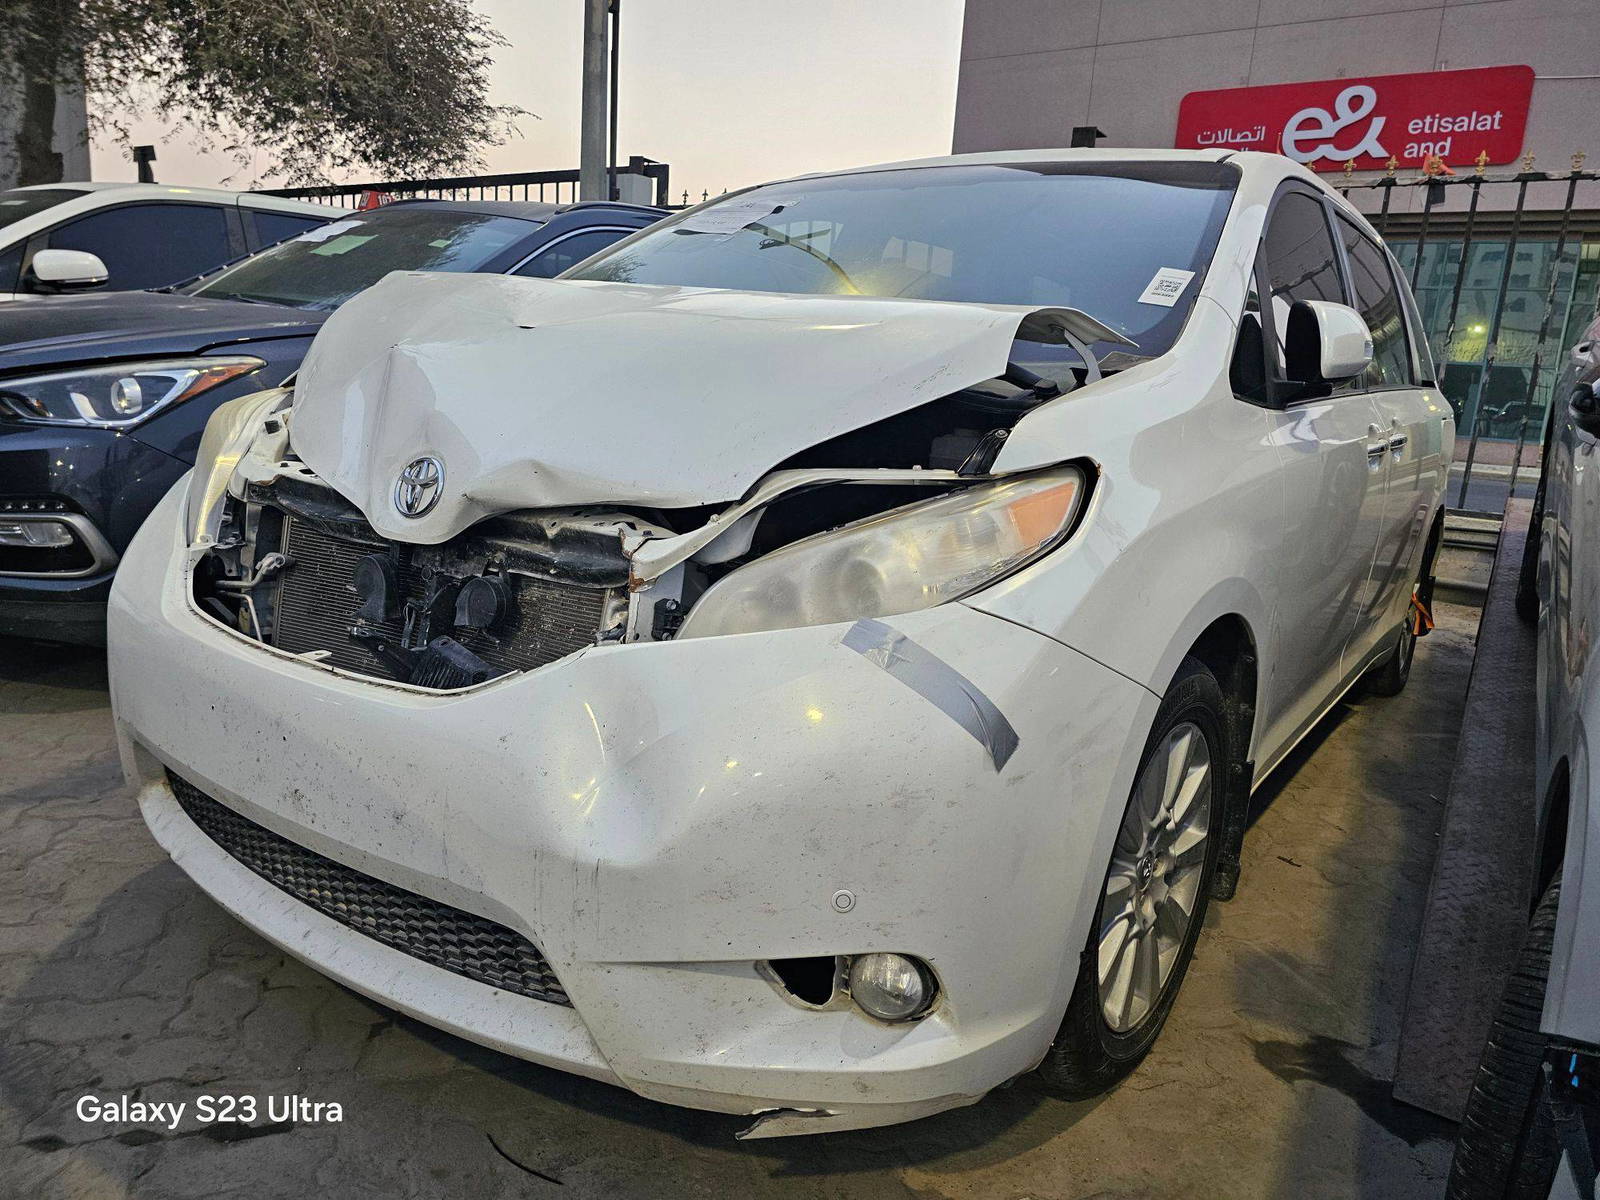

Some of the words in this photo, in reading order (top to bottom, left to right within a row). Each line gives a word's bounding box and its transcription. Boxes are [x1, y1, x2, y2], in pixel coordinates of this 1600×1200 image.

[1408, 110, 1503, 135] etisalat
[1197, 126, 1266, 145] اتصالات
[1404, 136, 1452, 158] and
